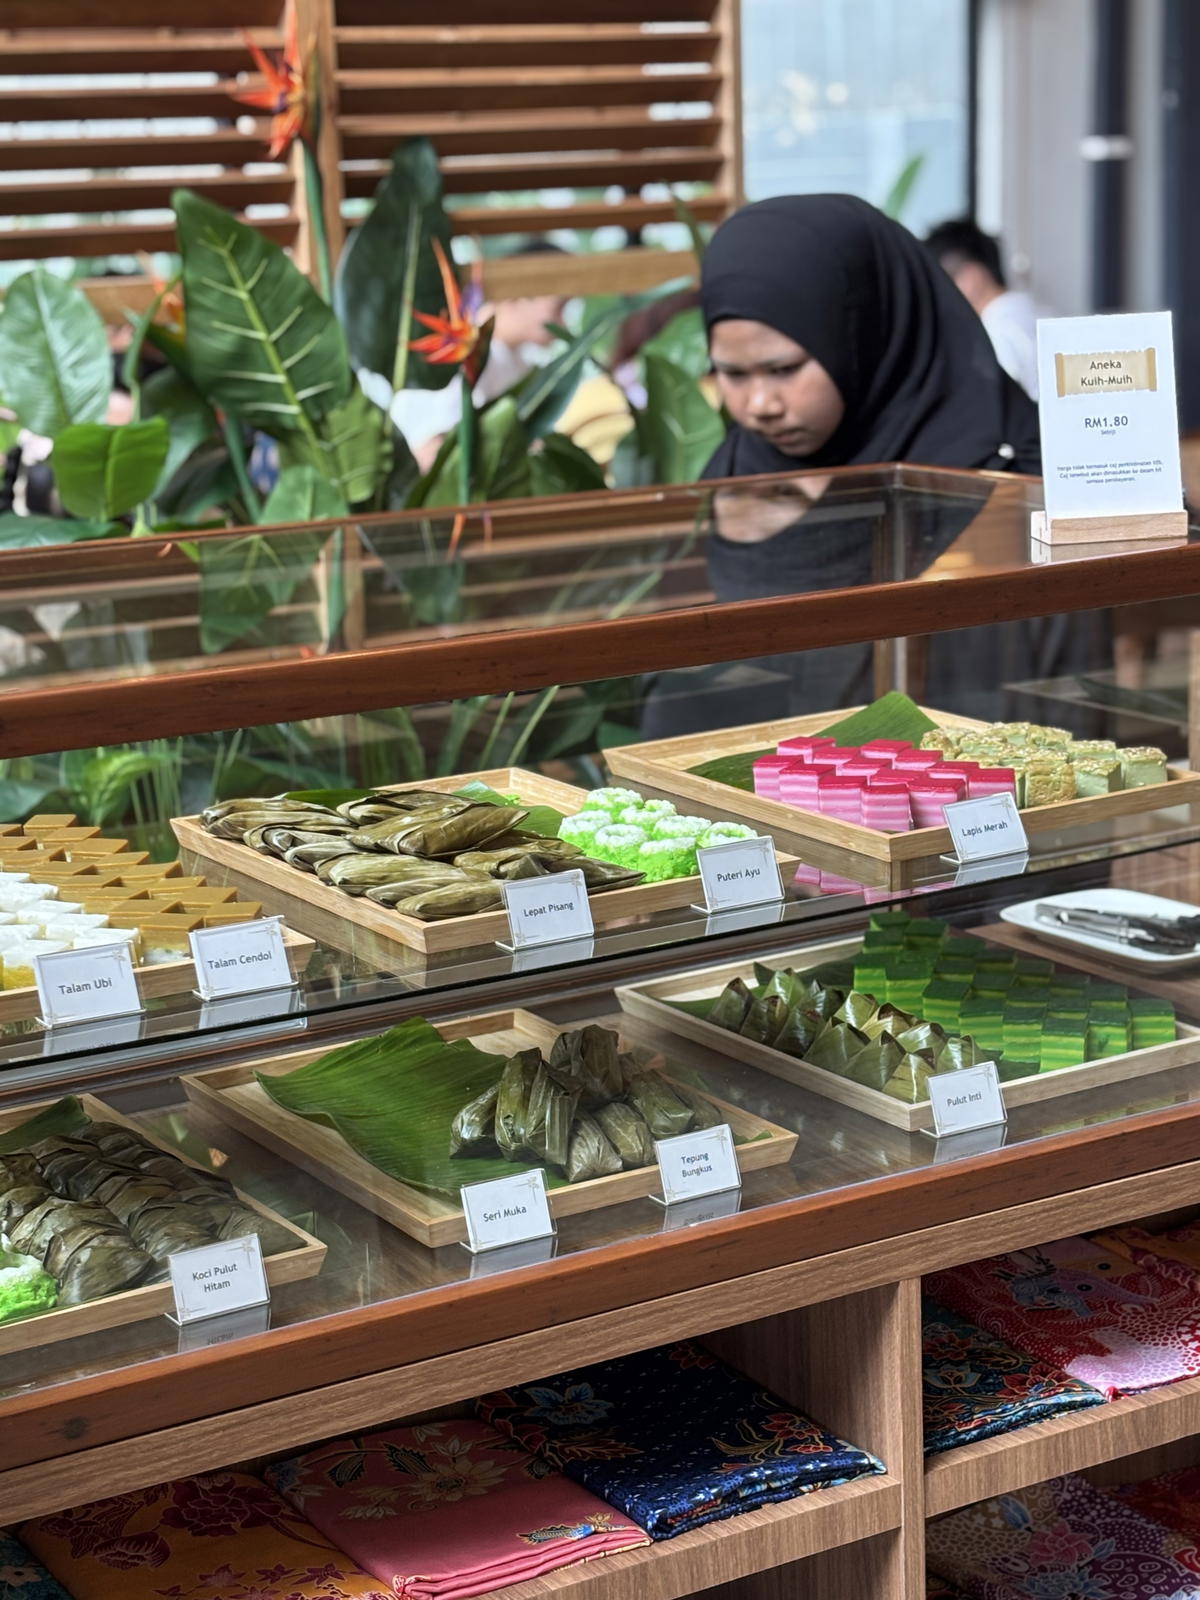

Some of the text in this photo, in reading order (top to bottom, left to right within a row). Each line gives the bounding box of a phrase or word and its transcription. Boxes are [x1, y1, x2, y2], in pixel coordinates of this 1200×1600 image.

[1089, 360, 1122, 370] Aneka
[1080, 374, 1133, 387] Kuih-Muih
[1084, 415, 1129, 428] RM1.80
[962, 820, 1008, 838] Lapis Merah
[717, 867, 761, 882] Puteri Ayu
[523, 902, 574, 917] Lepat Pisang
[207, 950, 272, 970] Talam Cendol
[58, 977, 113, 995] Talam Ubi
[946, 1091, 982, 1107] Pulut Inti
[681, 1152, 709, 1165] Tepung
[681, 1164, 713, 1178] Bungkus
[483, 1205, 527, 1222] Seri Muka
[192, 1263, 238, 1281] Koci Pulut
[204, 1280, 231, 1293] Hitam
